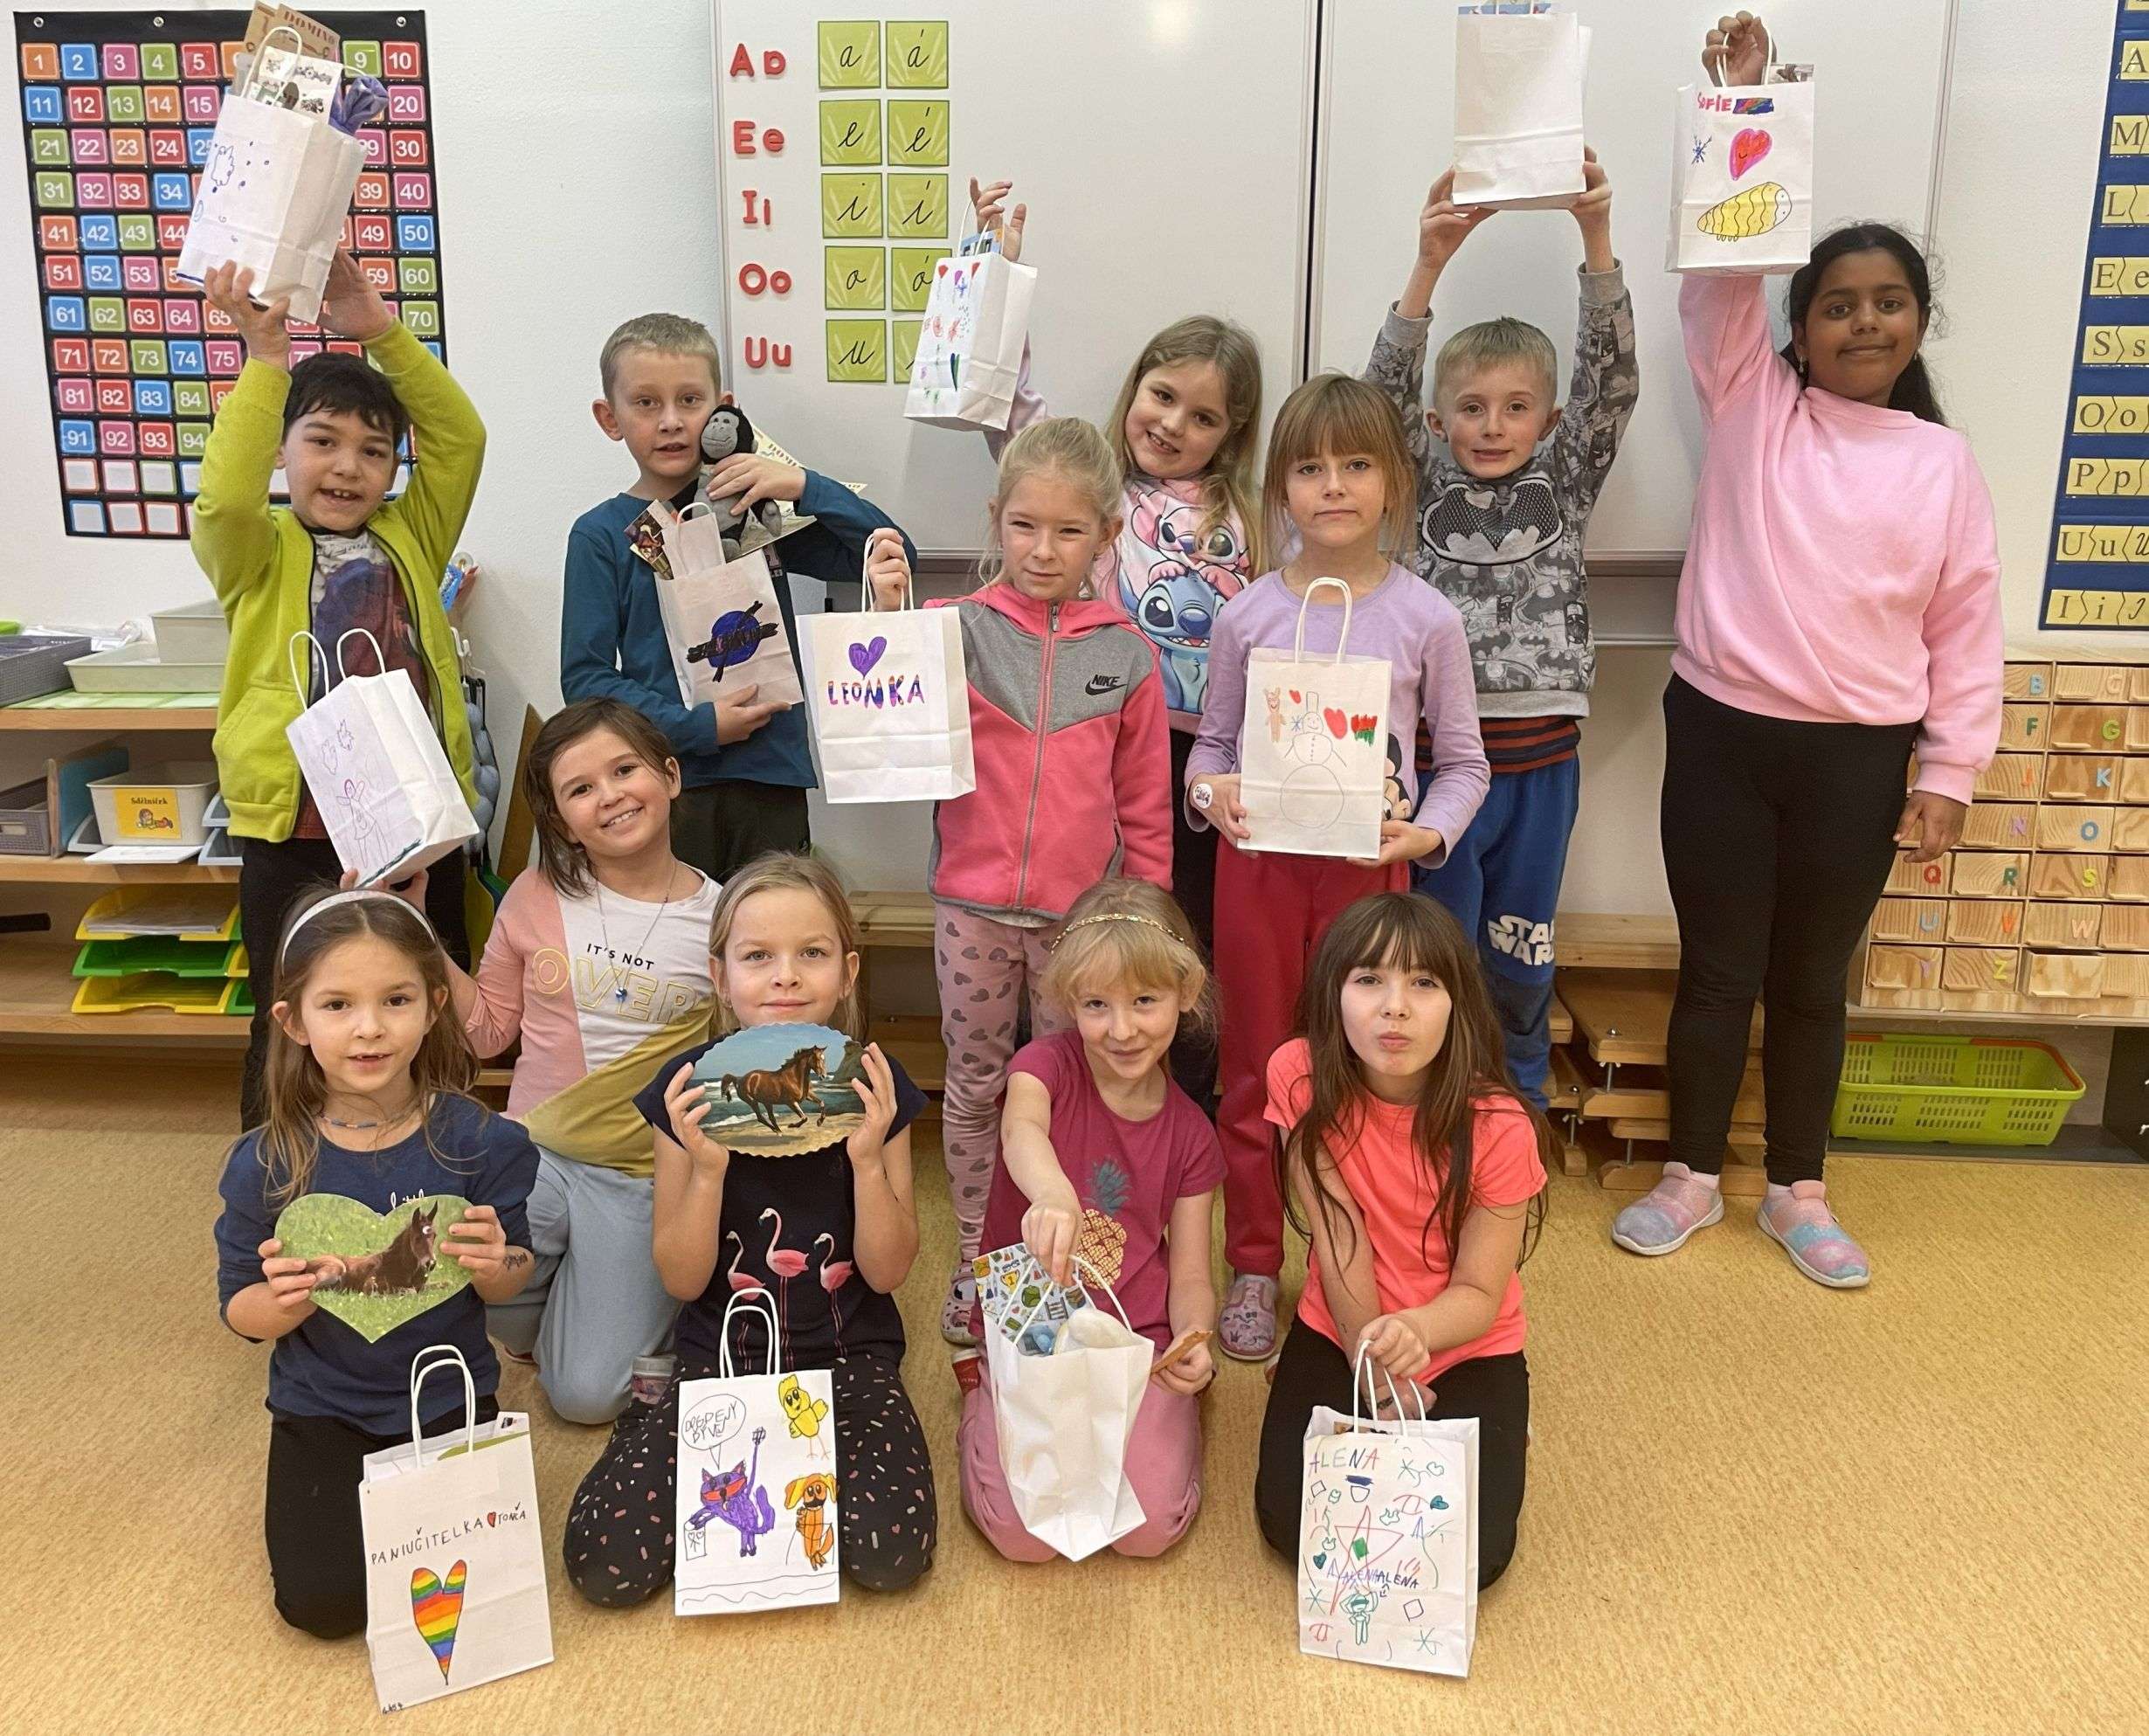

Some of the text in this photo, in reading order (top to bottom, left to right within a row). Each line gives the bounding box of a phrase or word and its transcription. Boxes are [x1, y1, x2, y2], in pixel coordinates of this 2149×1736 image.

[840, 29, 930, 68] a á
[34, 52, 411, 71] 1 2 3 4 5 9 10
[2123, 47, 2148, 73] A
[32, 96, 418, 114] 11 12 13 14 15 20
[838, 121, 864, 148] e
[2112, 121, 2141, 147] M
[40, 139, 60, 156] 21
[78, 139, 100, 156] 22
[116, 139, 139, 156] 23
[155, 140, 179, 156] 24
[396, 140, 419, 157] 30
[44, 182, 425, 200] 31 32 33 34 39 40
[2105, 191, 2126, 217] L
[47, 225, 68, 242] 41
[86, 225, 110, 241] 42
[124, 225, 147, 241] 43
[361, 225, 384, 242] 49
[404, 225, 428, 241] 50
[52, 265, 73, 281] 51
[91, 266, 114, 281] 52
[129, 266, 151, 283] 53
[366, 268, 389, 285] 59
[404, 268, 429, 284] 60
[846, 268, 866, 290] o
[2095, 263, 2149, 289] E e
[56, 307, 432, 327] 61 62 63 64 65 70
[2093, 330, 2146, 357] S s
[61, 349, 81, 365] 71
[99, 349, 121, 365] 72
[138, 350, 159, 366] 73
[175, 350, 197, 367] 74
[212, 350, 235, 367] 75
[66, 388, 85, 405] 81
[102, 389, 125, 405] 82
[141, 391, 163, 406] 83
[180, 391, 202, 407] 84
[2079, 402, 2137, 428] O o
[67, 430, 204, 448] 91 92 93 94
[2074, 463, 2131, 495] P p
[2061, 532, 2084, 556] U
[2100, 539, 2116, 557] u
[2057, 595, 2073, 619] I
[2097, 596, 2105, 619] i
[827, 674, 925, 709] LEONKA
[1091, 674, 1121, 687] NIKE
[2029, 674, 2043, 695] B
[2027, 717, 2120, 741] F G
[2097, 767, 2111, 788] K
[2082, 821, 2099, 841] O
[1924, 864, 2097, 888] Q R S
[1488, 915, 1555, 944] STA
[1919, 912, 1939, 932] U
[2071, 917, 2094, 939] W
[622, 952, 654, 971] NOT
[1993, 959, 2007, 981] Z
